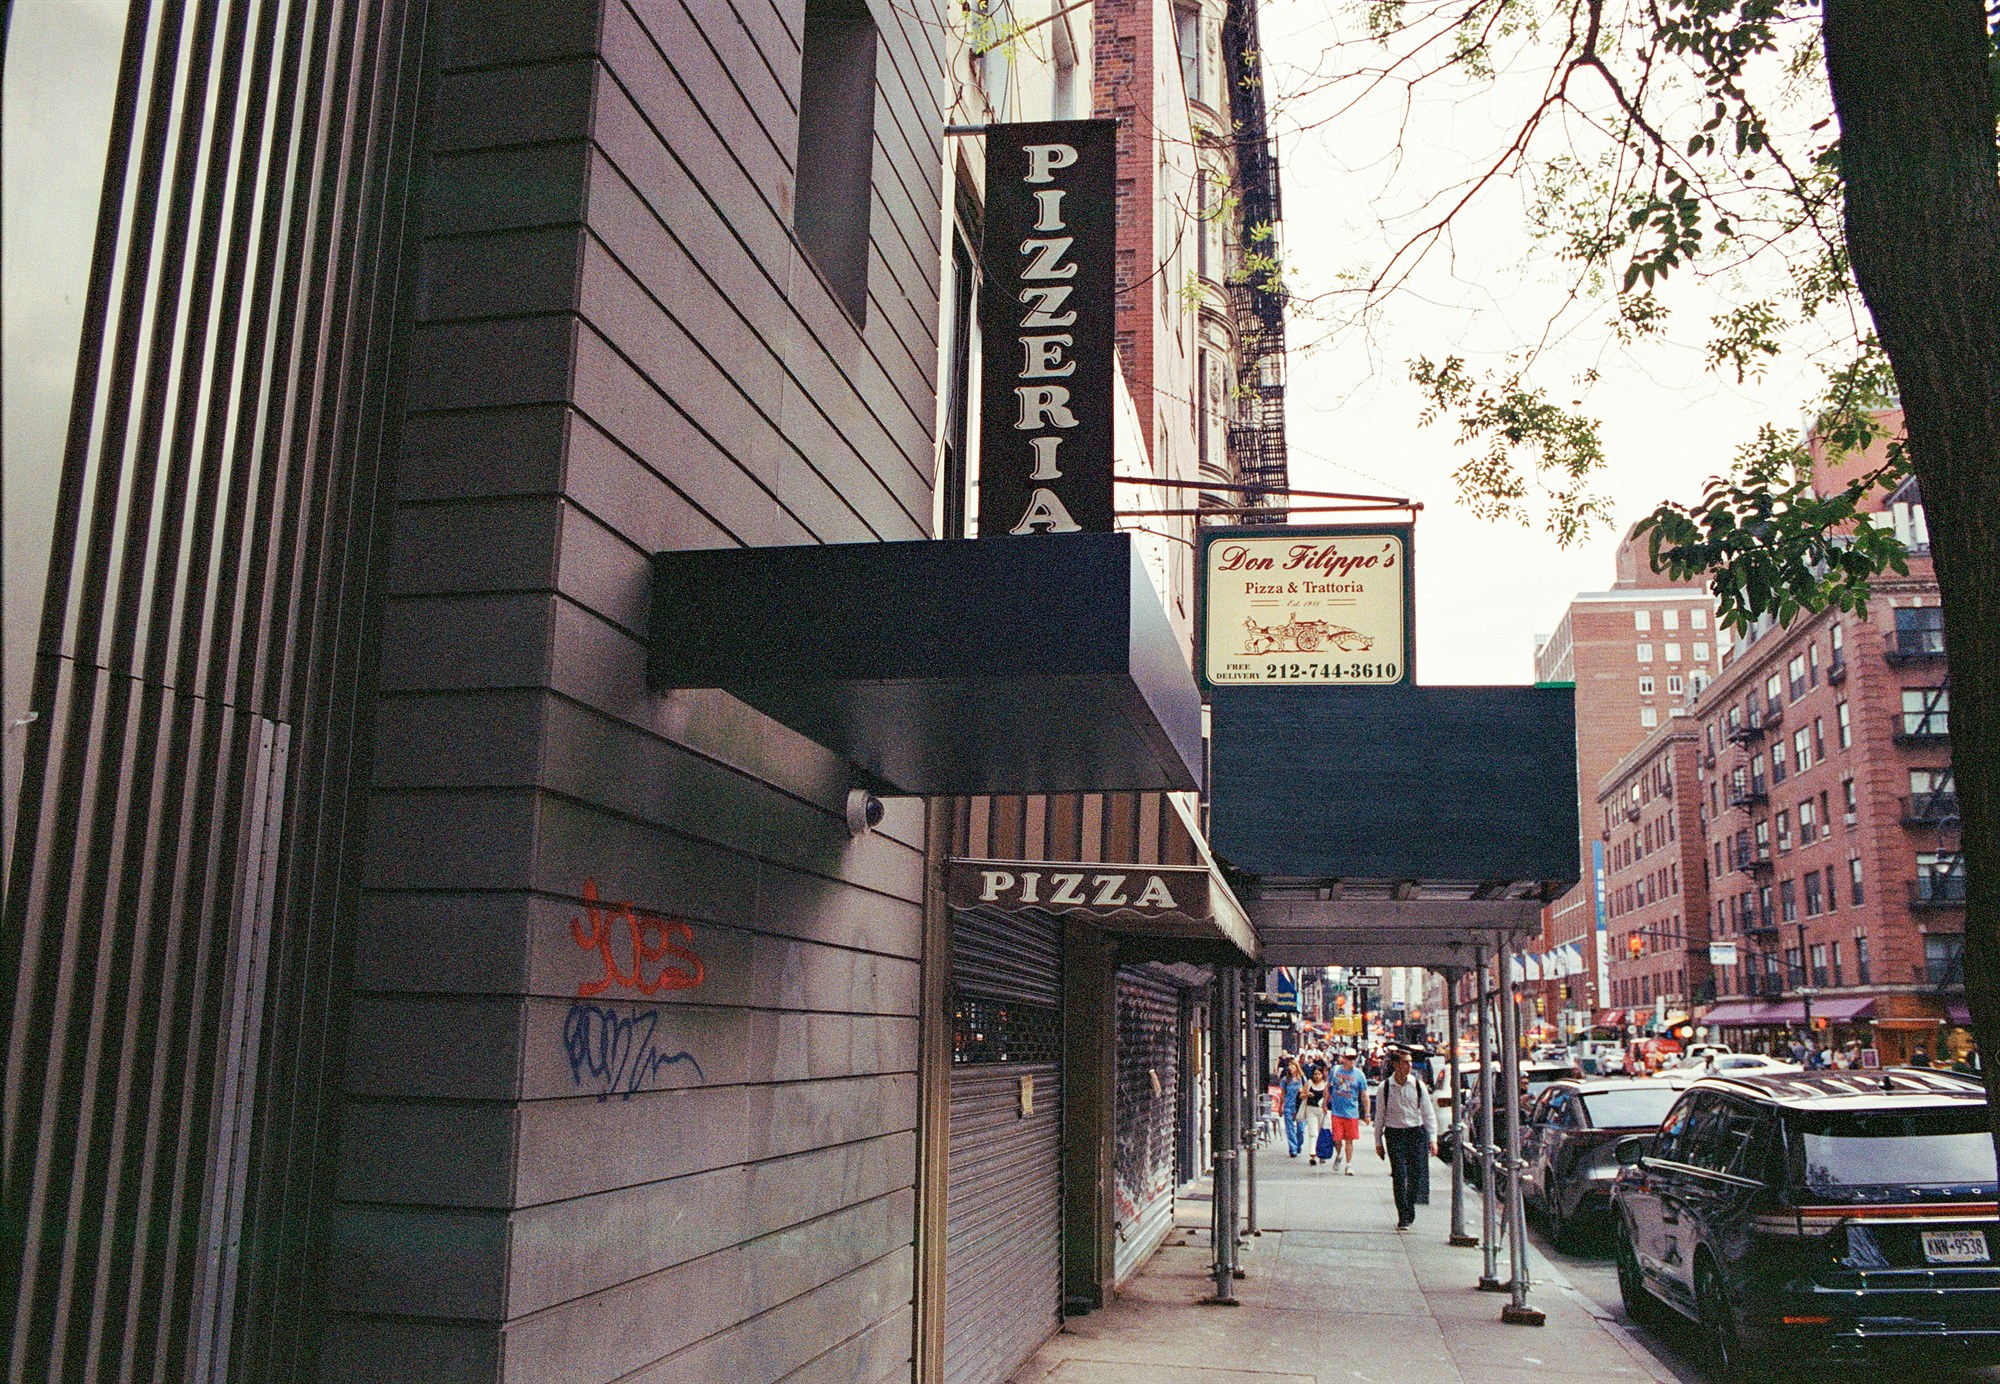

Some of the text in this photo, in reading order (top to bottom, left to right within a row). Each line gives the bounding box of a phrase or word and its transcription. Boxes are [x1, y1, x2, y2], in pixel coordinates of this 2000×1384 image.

[1008, 143, 1083, 536] PIZZERIA
[1217, 543, 1395, 577] Don Filippo's
[1245, 580, 1364, 594] Pizza & Trattoria
[1266, 663, 1397, 679] 212-744-3610
[979, 871, 1178, 908] PIZZA
